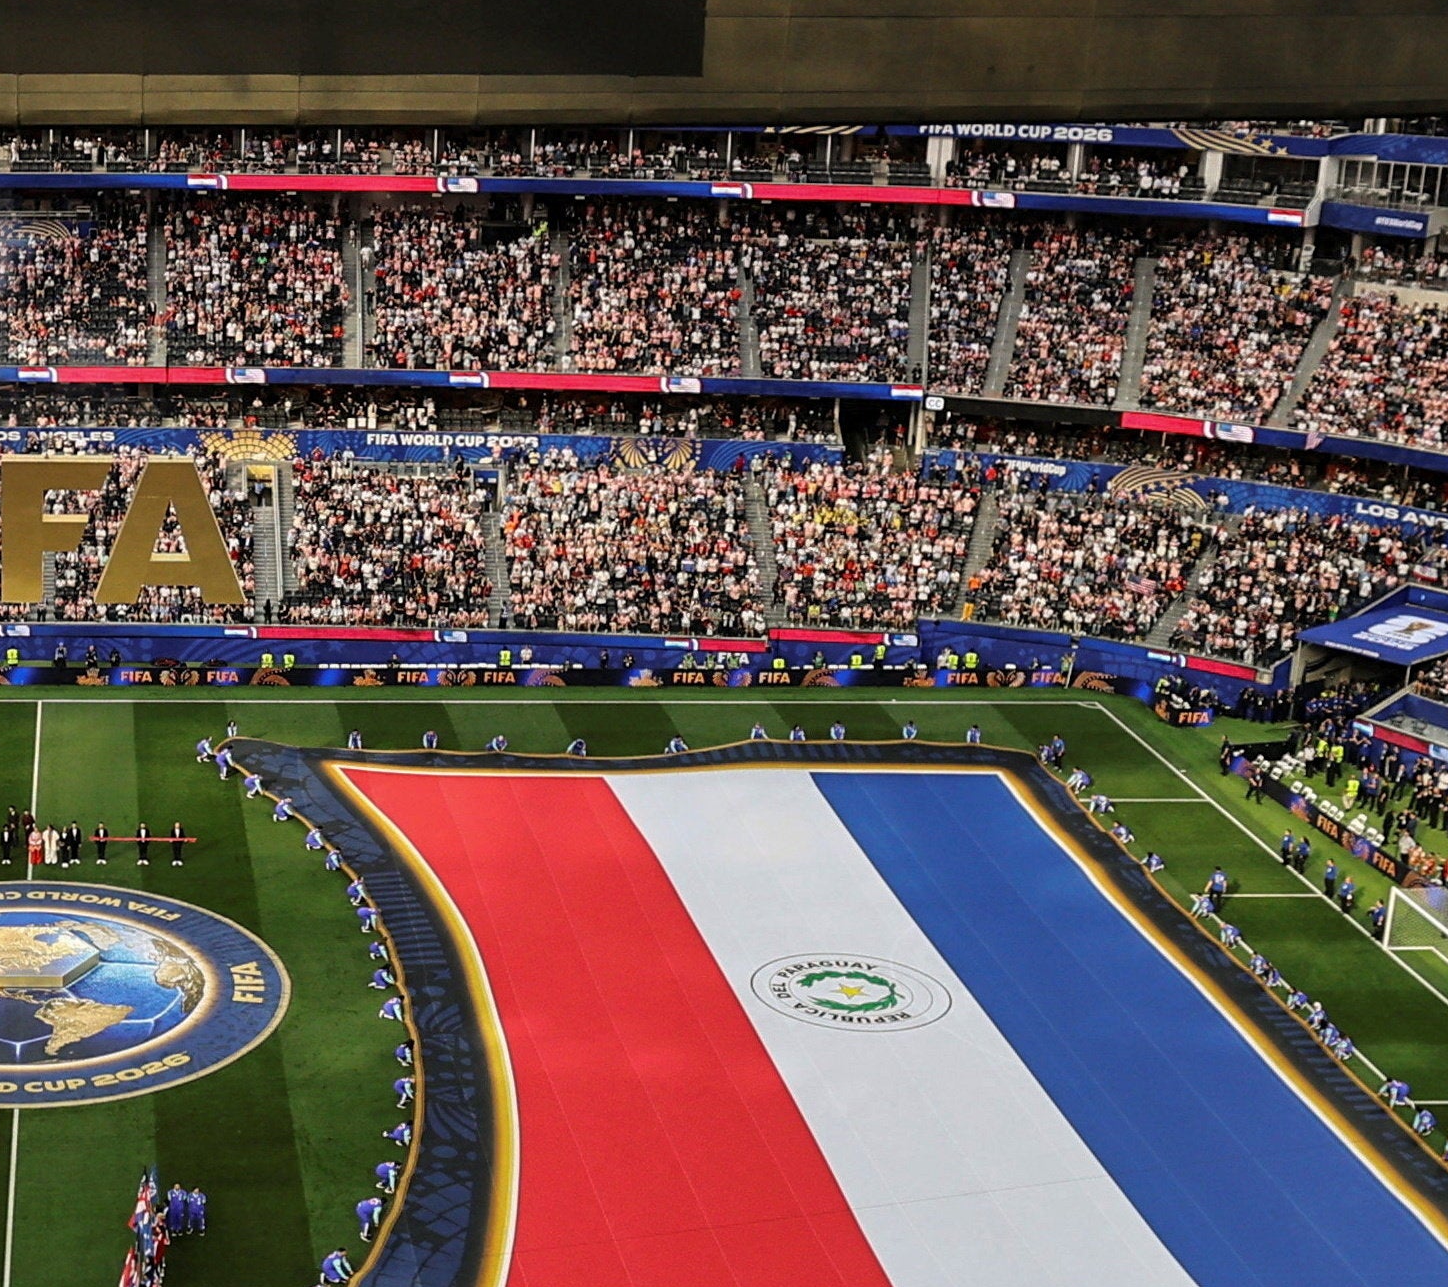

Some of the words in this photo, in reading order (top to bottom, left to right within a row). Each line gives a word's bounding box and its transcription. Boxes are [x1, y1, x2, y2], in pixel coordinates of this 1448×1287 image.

[957, 124, 1014, 139] WORLD
[1018, 126, 1052, 139] CUP
[1053, 127, 1113, 141] 2026
[928, 399, 942, 408] CC
[367, 434, 400, 446] FIFA
[401, 435, 454, 446] WORLD
[456, 436, 485, 447] CUP
[1356, 501, 1398, 520] LOS
[120, 670, 152, 682] FIFA
[207, 670, 239, 682] FIFA
[397, 672, 429, 684] FIFA
[483, 672, 515, 684] FIFA
[673, 672, 704, 684] FIFA
[759, 672, 790, 684] FIFA
[947, 673, 978, 686] FIFA
[1179, 711, 1210, 724] FIFA
[1316, 814, 1338, 838] FIFA
[1372, 851, 1396, 877] FIFA
[27, 889, 122, 908] WORLD
[128, 900, 181, 922] FIFA
[778, 960, 879, 979] PARAGUAY
[231, 961, 264, 1004] FIFA
[772, 981, 792, 999] DEL
[794, 1003, 912, 1024] REPUBLICA
[23, 1077, 85, 1093] CUP
[89, 1051, 192, 1088] 2026
